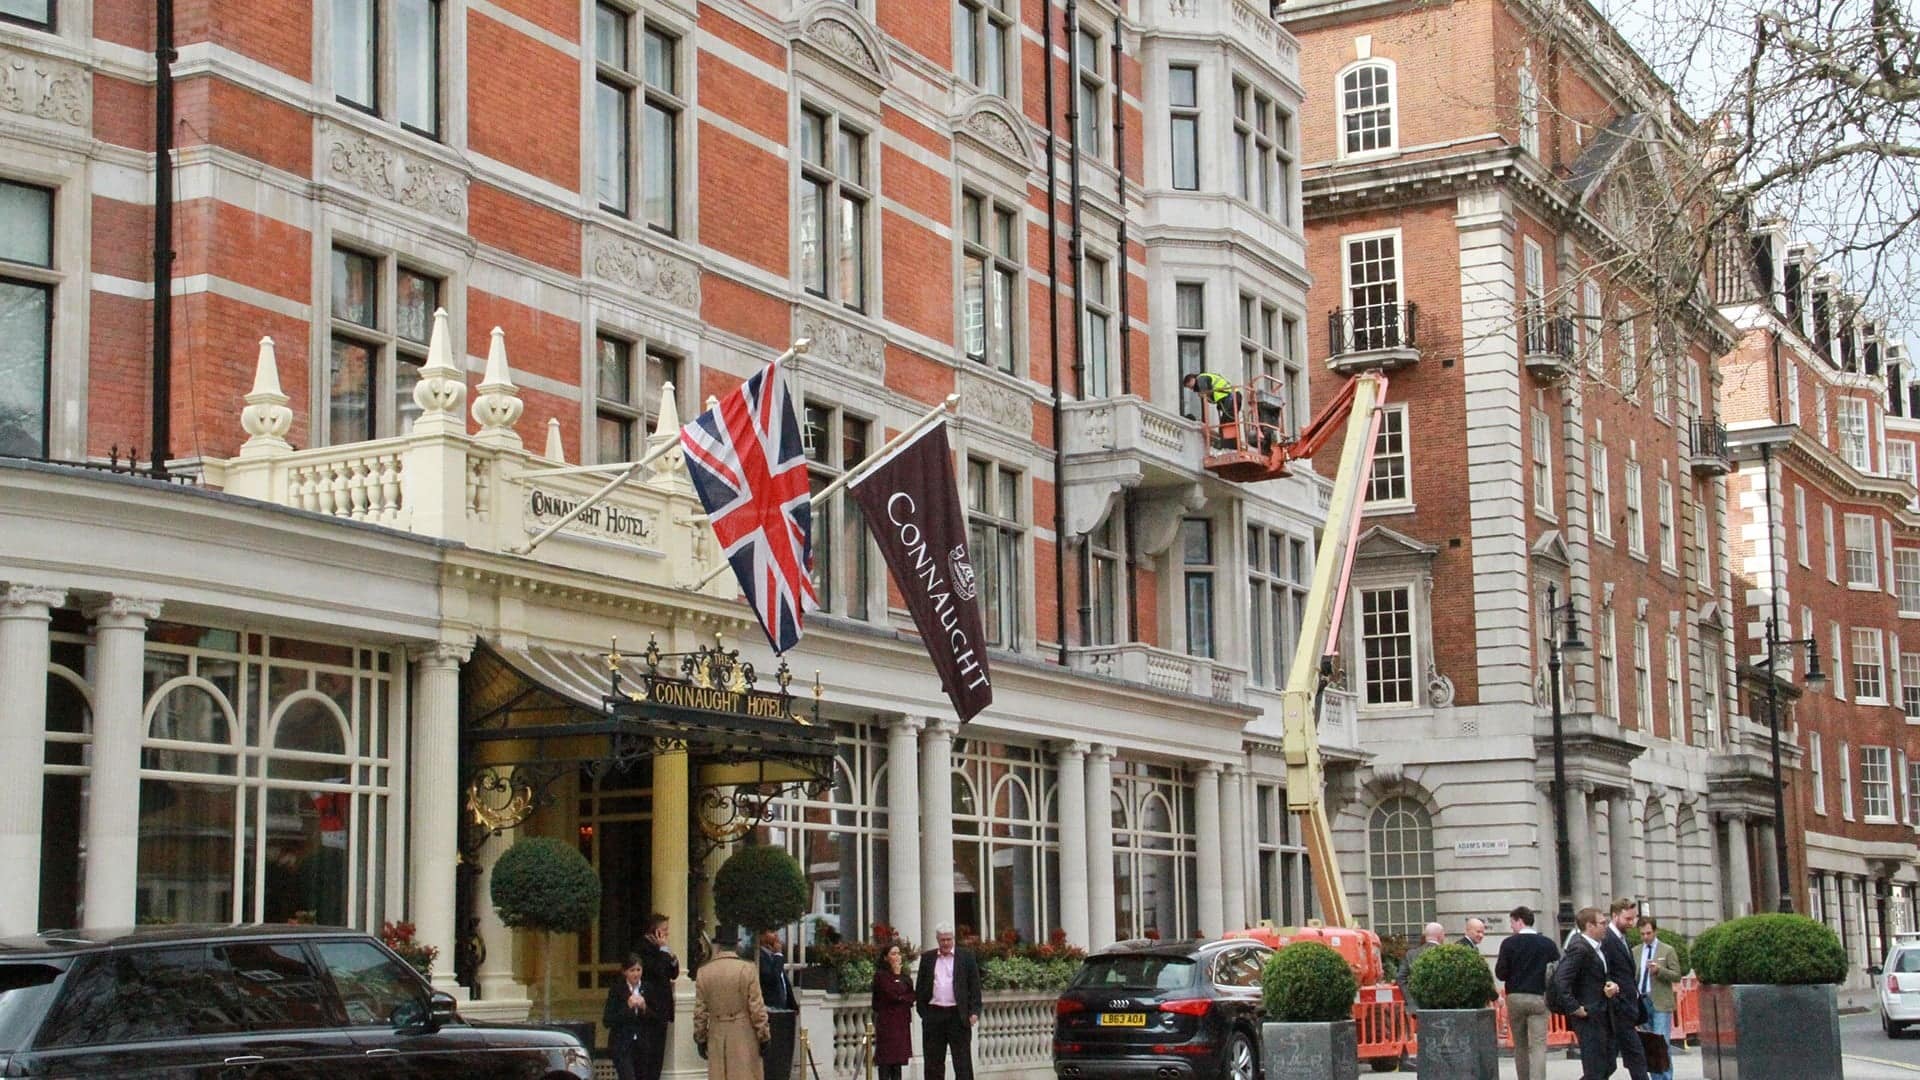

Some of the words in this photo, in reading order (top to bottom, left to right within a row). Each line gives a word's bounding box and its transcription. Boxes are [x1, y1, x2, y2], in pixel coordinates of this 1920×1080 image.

[605, 506, 649, 537] HOTEL
[888, 492, 990, 690] CONNAUGHT
[714, 653, 730, 666] THE
[656, 684, 740, 712] CONNAUGHT
[747, 696, 785, 719] HOTEL
